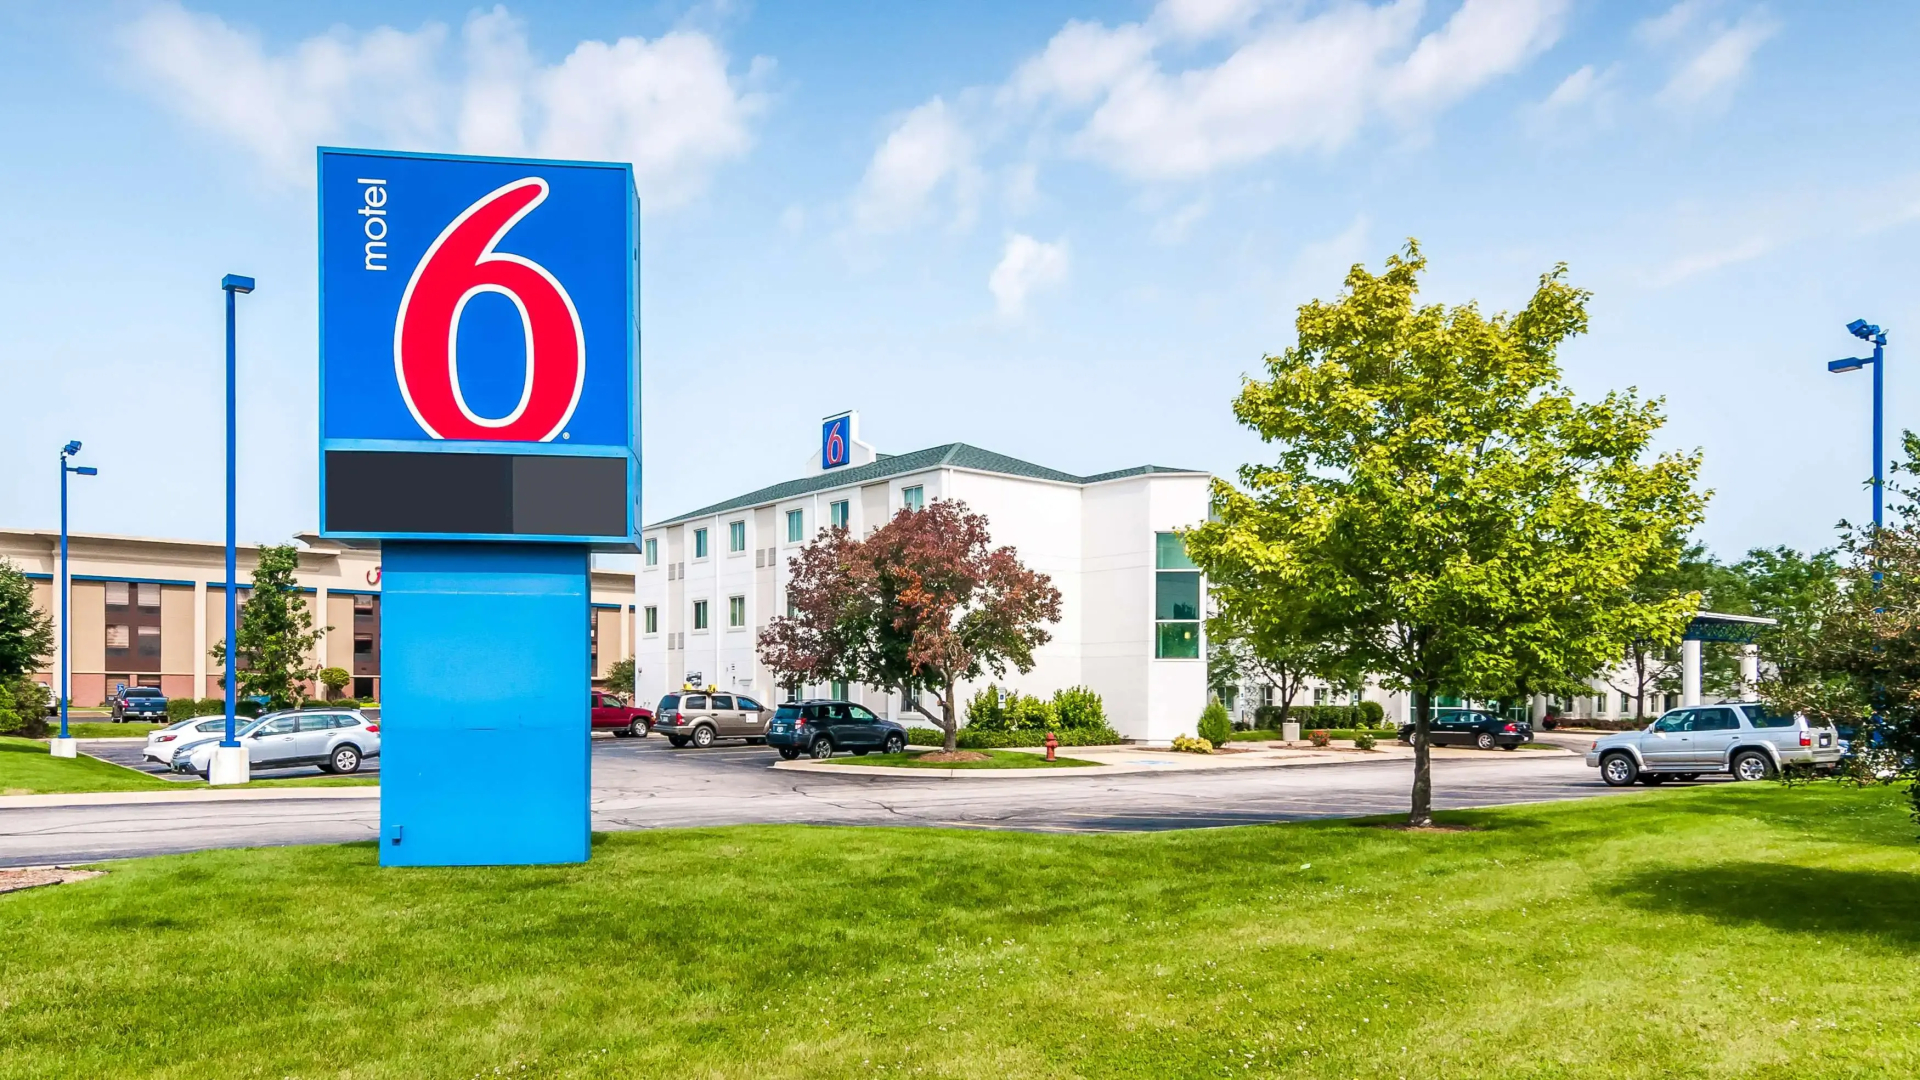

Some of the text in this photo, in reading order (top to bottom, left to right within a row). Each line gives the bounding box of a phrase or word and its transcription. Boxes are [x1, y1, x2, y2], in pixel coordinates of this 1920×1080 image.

[357, 176, 586, 443] motel 6
[827, 421, 844, 465] 6
